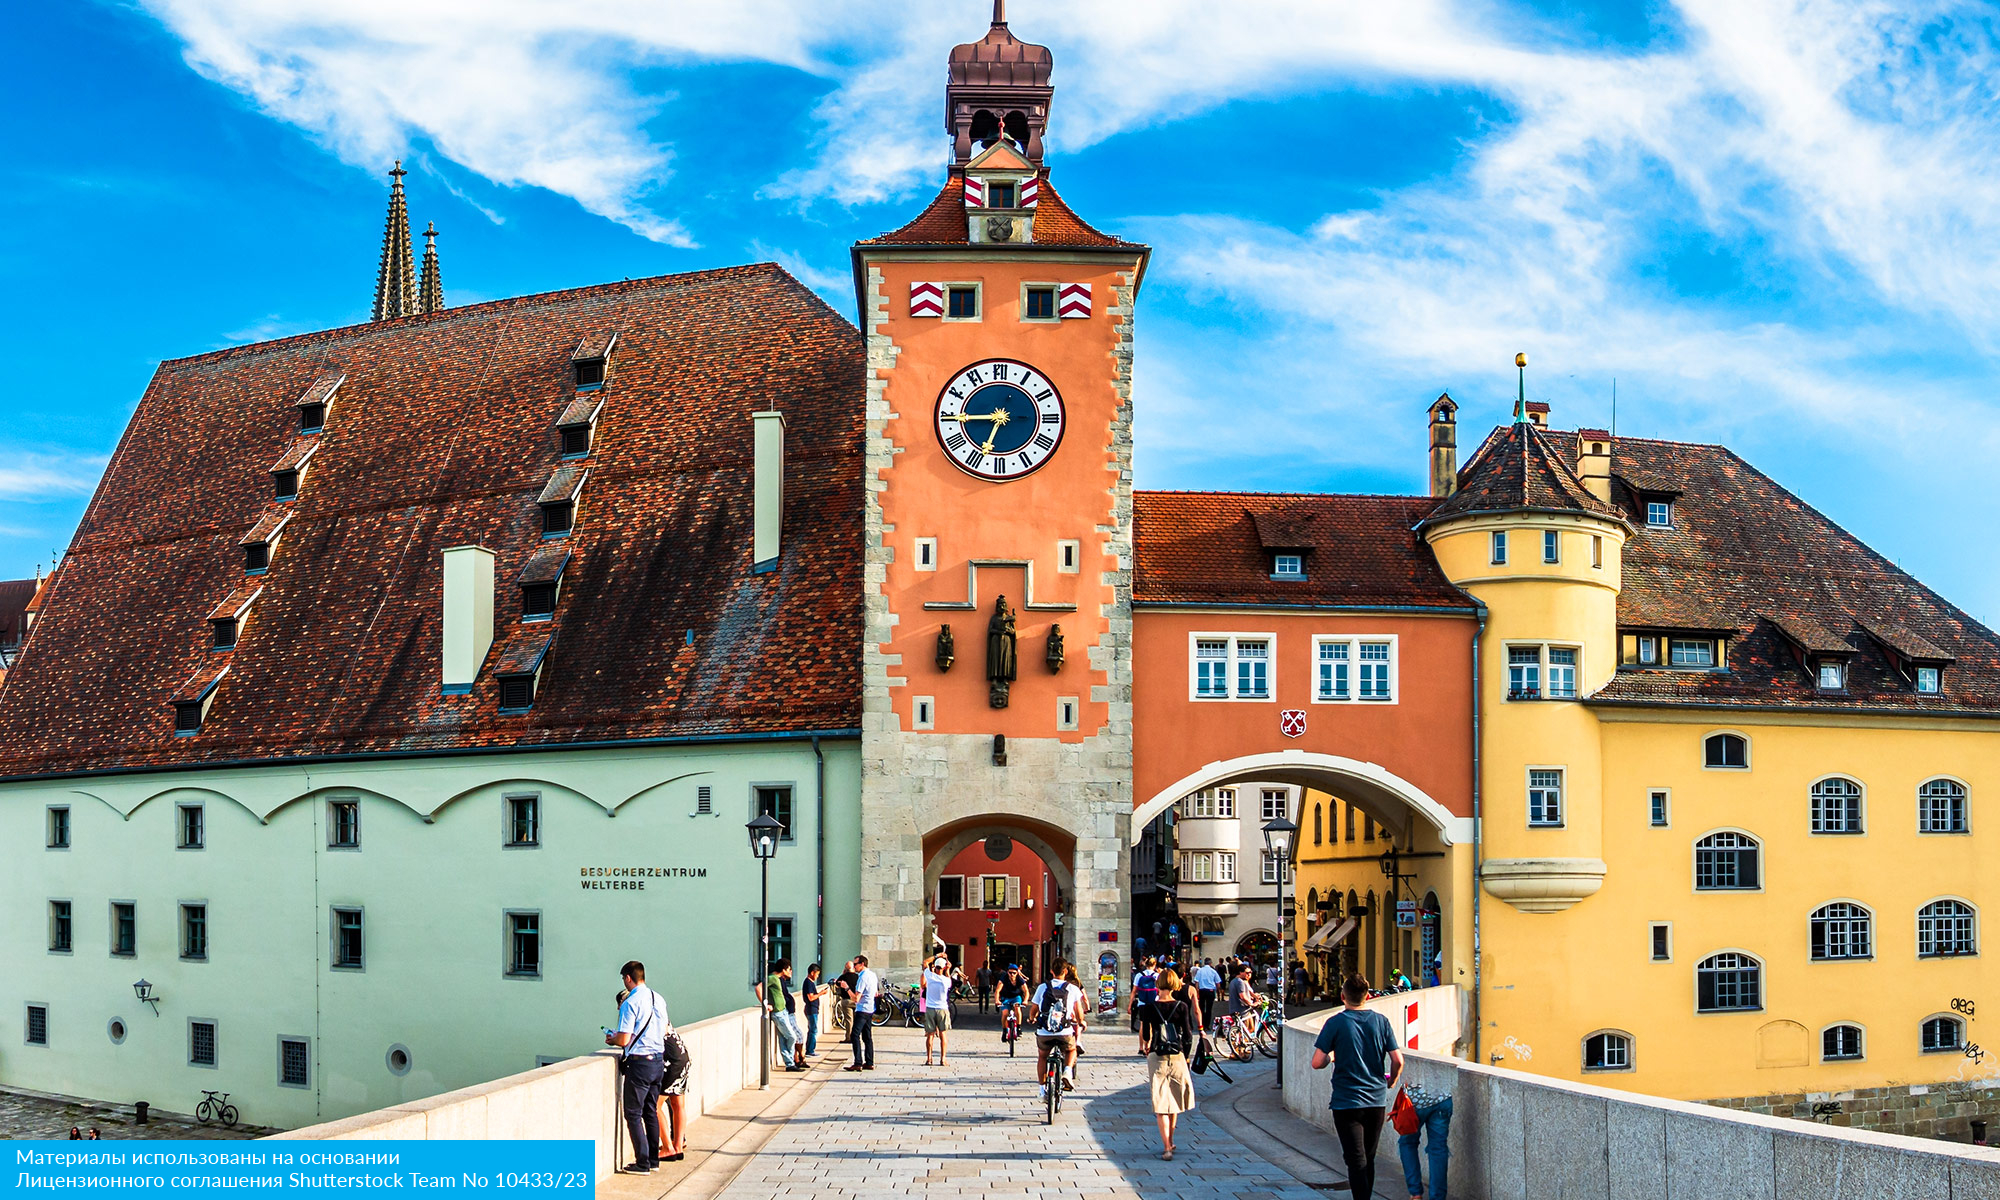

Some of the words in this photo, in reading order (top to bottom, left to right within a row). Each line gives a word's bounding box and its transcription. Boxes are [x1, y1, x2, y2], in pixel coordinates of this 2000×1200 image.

[1035, 389, 1053, 402] II
[1042, 413, 1059, 424] III
[581, 867, 707, 878] BESUCHERZENTRUM
[581, 880, 645, 891] WELTERBE
